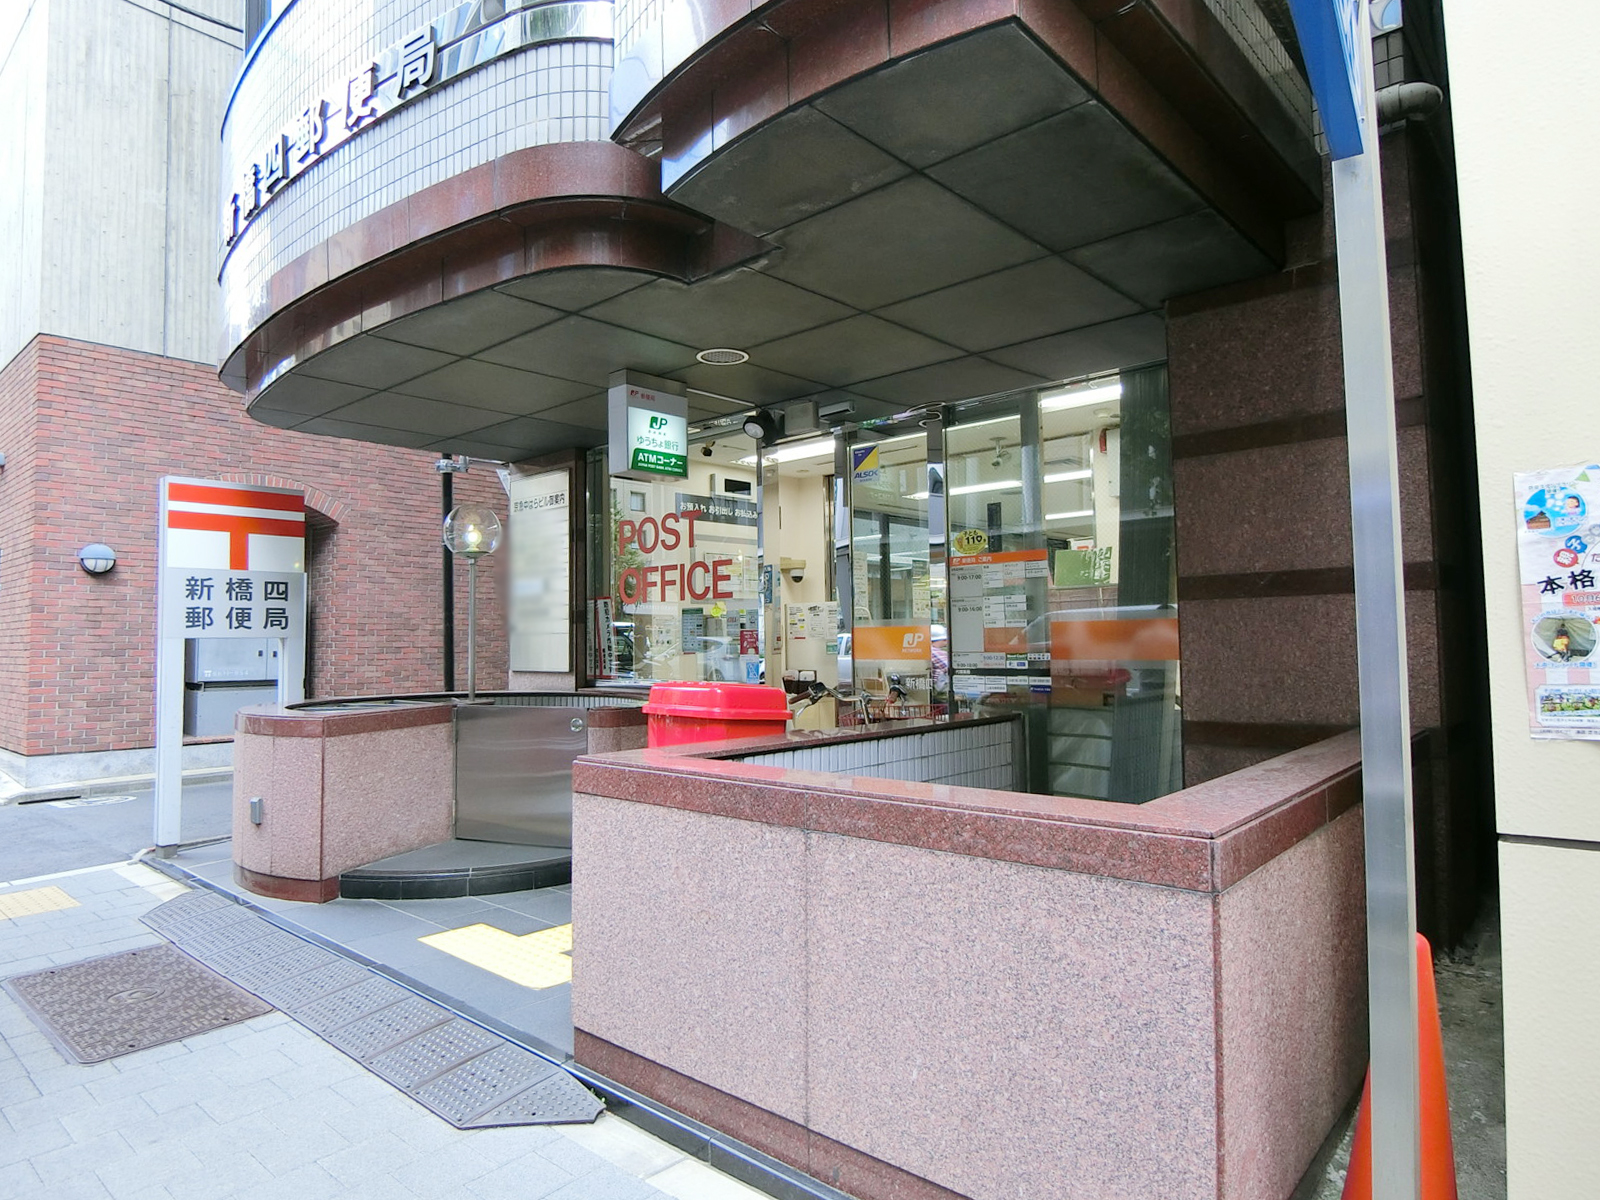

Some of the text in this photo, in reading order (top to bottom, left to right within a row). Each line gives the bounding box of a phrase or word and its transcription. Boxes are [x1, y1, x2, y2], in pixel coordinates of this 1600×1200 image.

[649, 415, 668, 430] JP
[636, 435, 679, 451] ゆうちょ銀行
[637, 452, 683, 467] ATMコーナー
[854, 470, 878, 479] ALSOK
[680, 502, 758, 519] お預入れ お引出し お払込み
[618, 510, 702, 556] POST
[185, 576, 289, 602] 新橋四
[618, 559, 733, 605] OFFICE
[1537, 569, 1595, 594] 本格
[185, 606, 289, 630] 郵便局
[903, 633, 924, 648] JP
